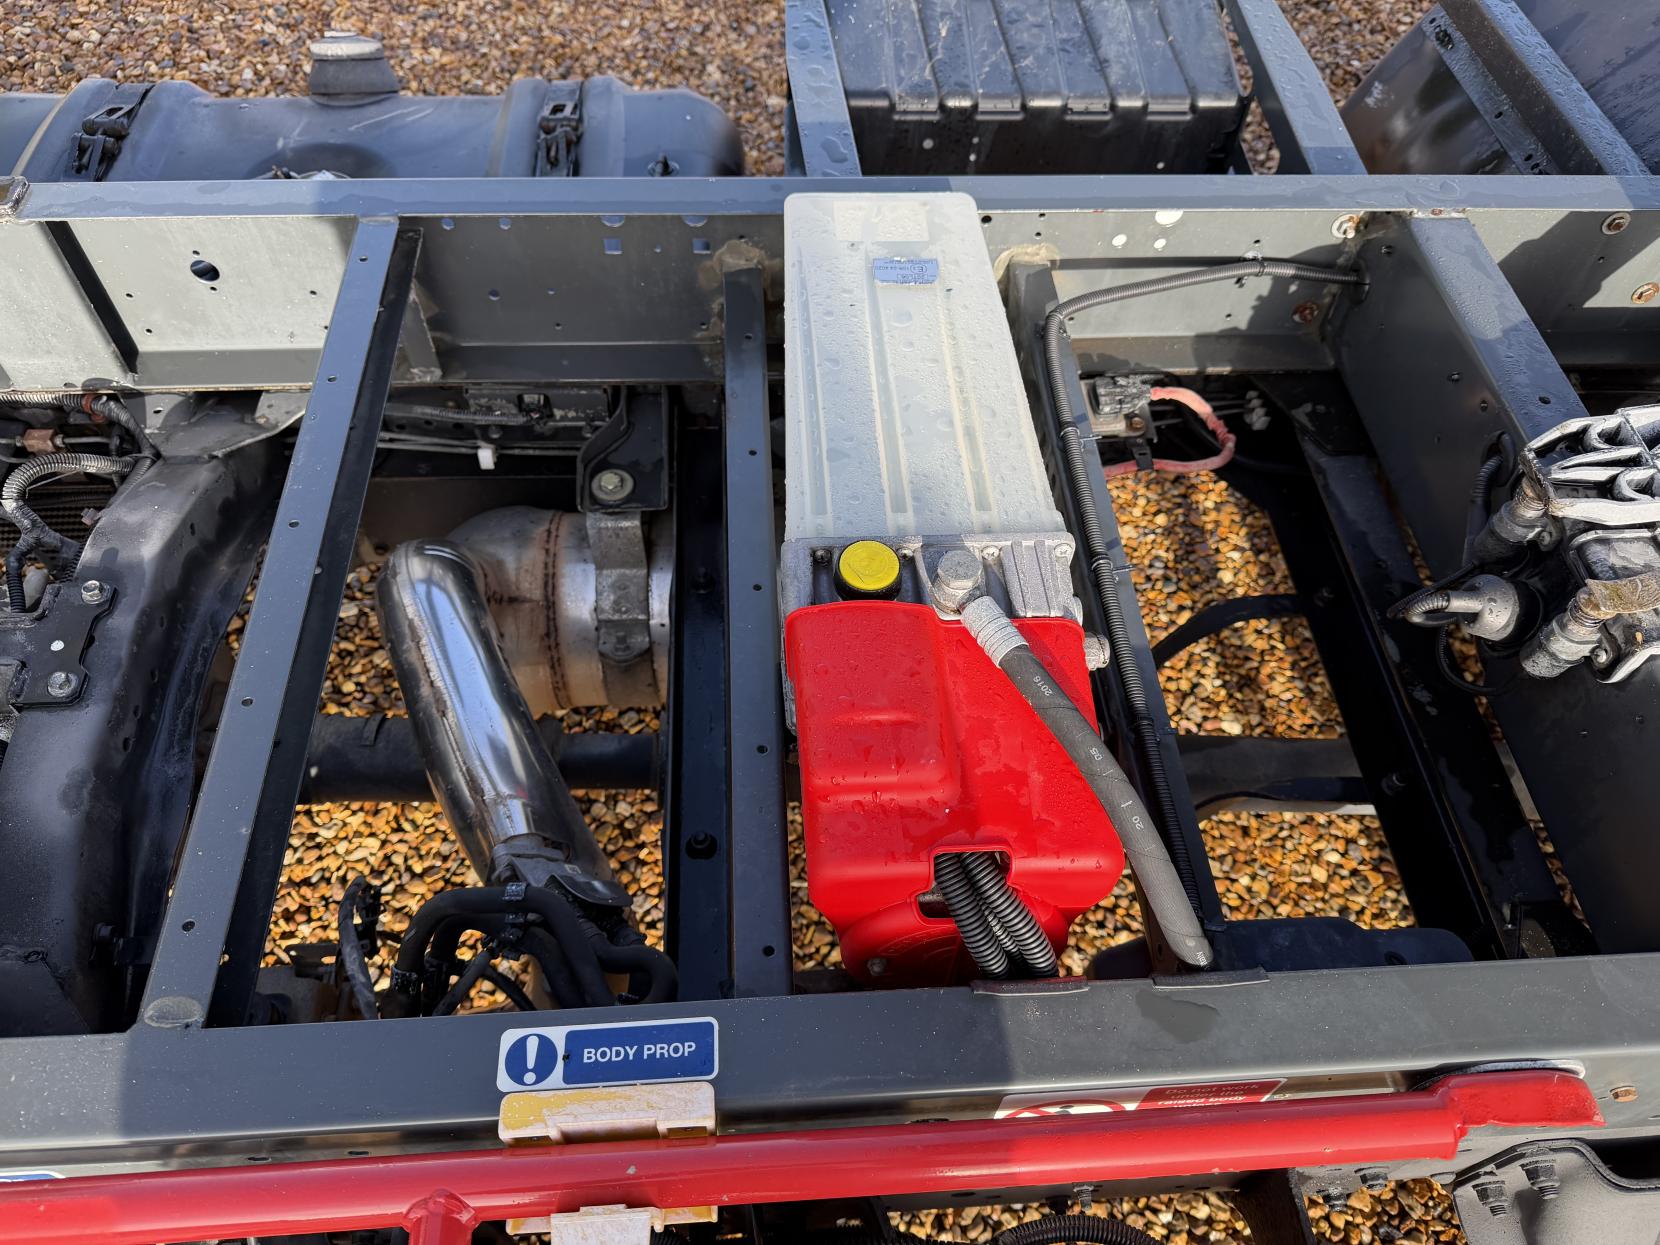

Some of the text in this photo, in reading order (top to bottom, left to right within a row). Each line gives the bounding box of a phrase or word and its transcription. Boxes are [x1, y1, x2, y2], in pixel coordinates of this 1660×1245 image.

[583, 1041, 697, 1063] BODY PROP
[1158, 1097, 1205, 1105] raised
